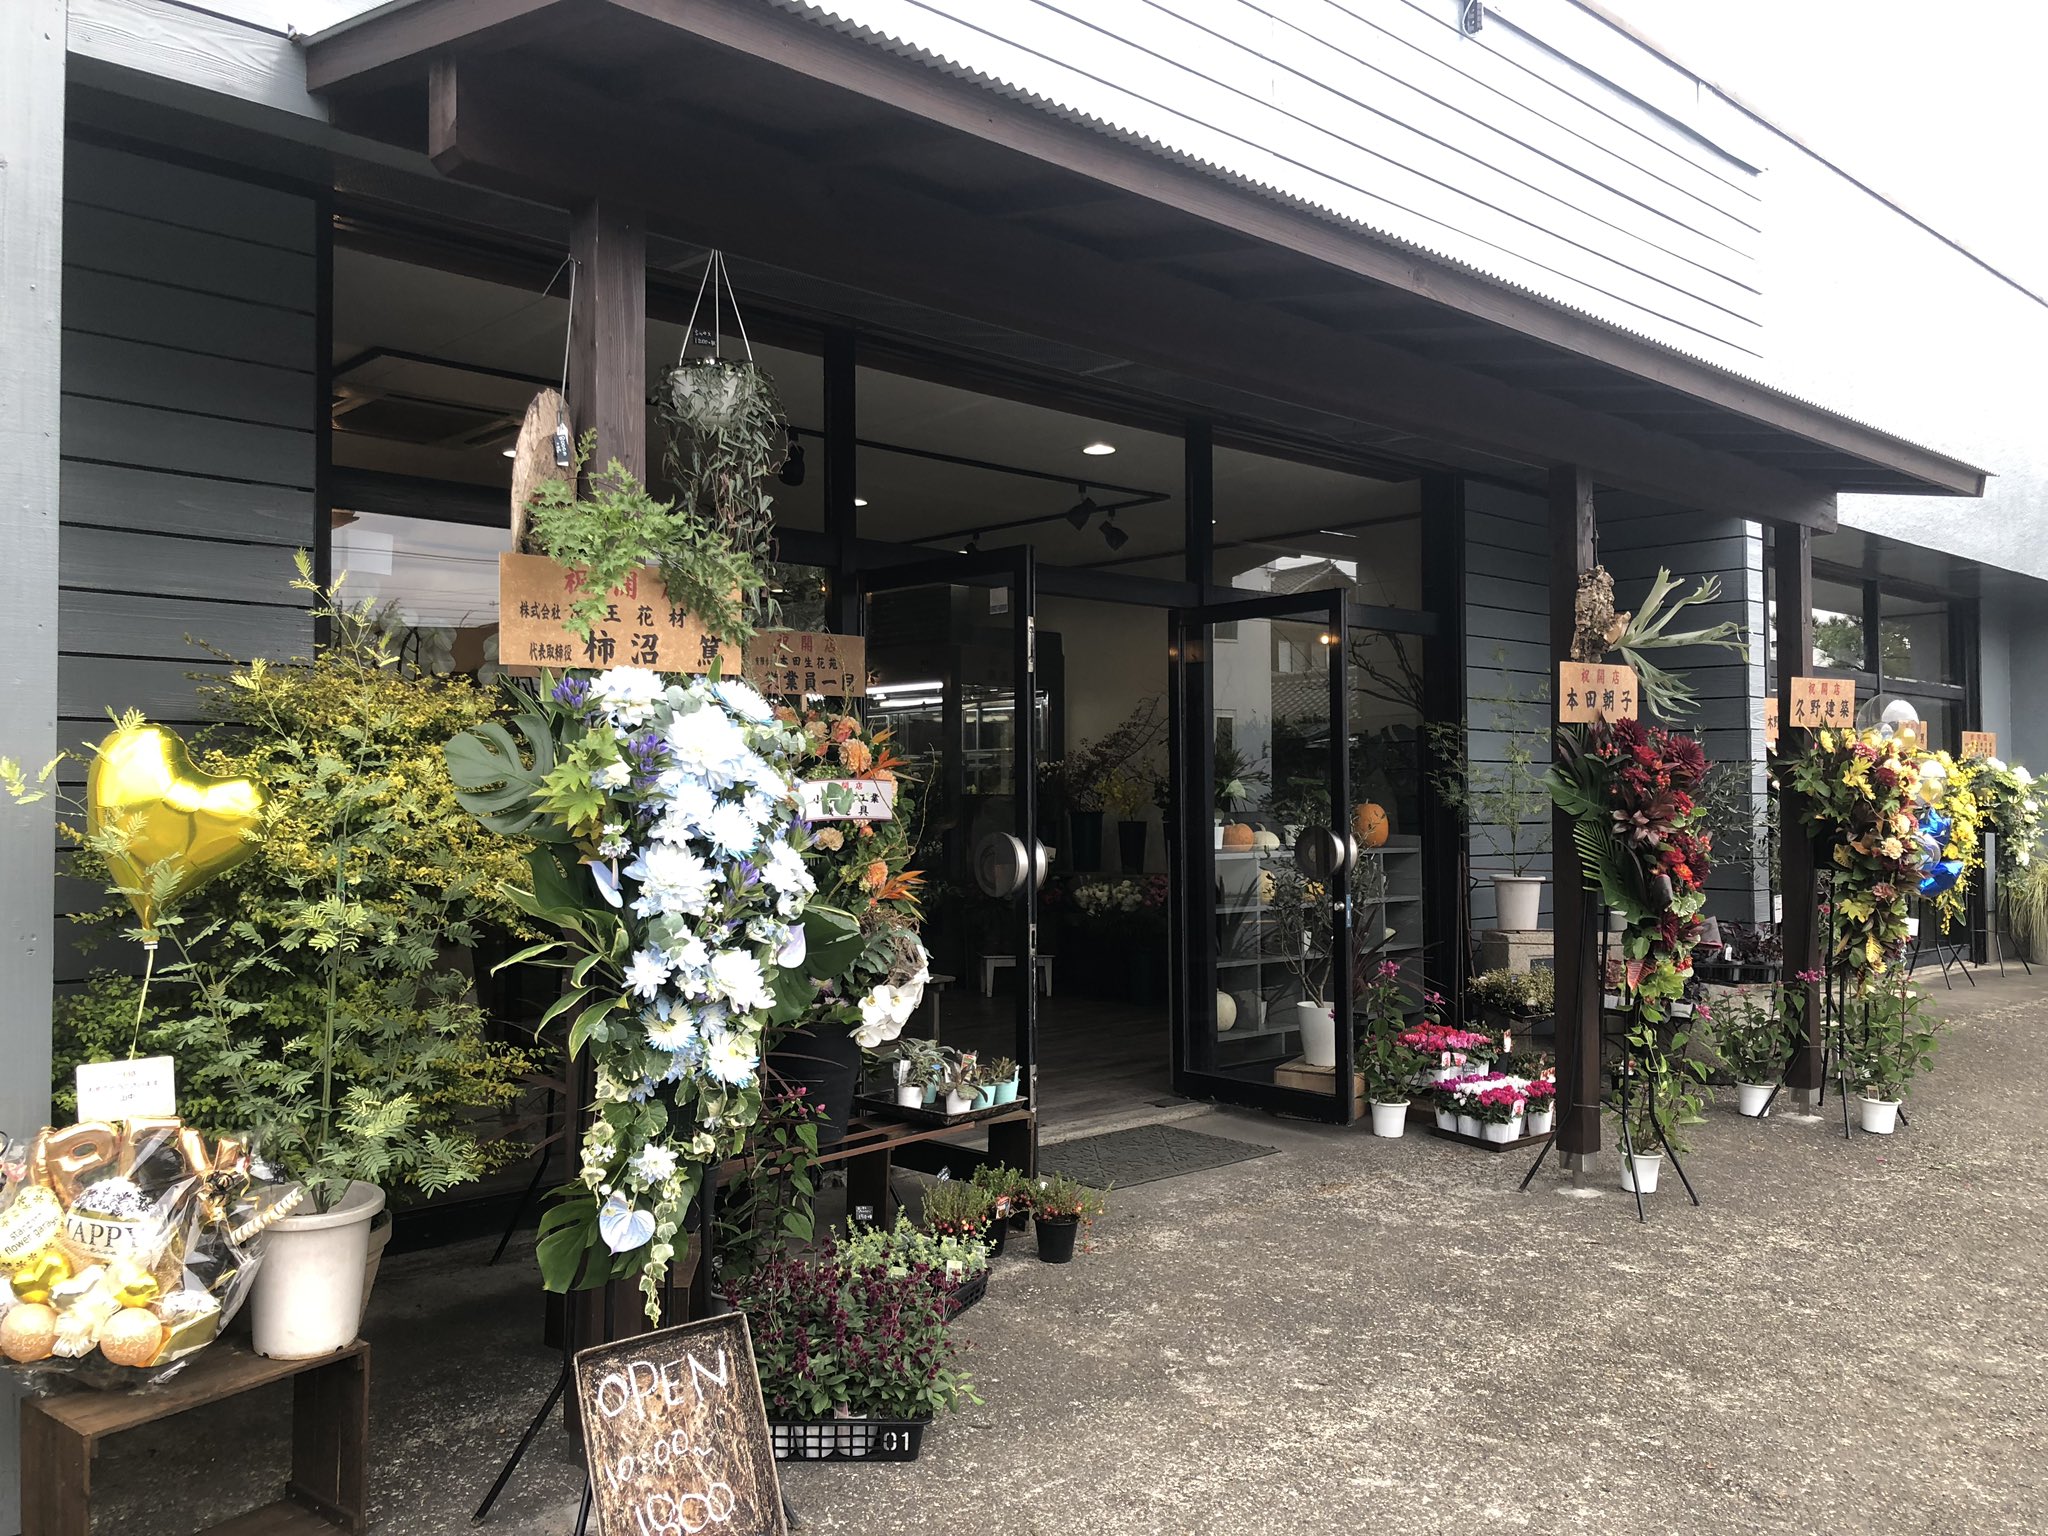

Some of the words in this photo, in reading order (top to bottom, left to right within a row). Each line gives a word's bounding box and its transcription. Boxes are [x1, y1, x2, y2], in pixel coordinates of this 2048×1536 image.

[1581, 668, 1620, 685] 祝開店
[1566, 687, 1633, 713] 本田朝子
[1795, 698, 1850, 719] 久野建築
[4, 1233, 32, 1255] flower
[598, 1349, 728, 1420] OPEN
[882, 1431, 909, 1451] 01
